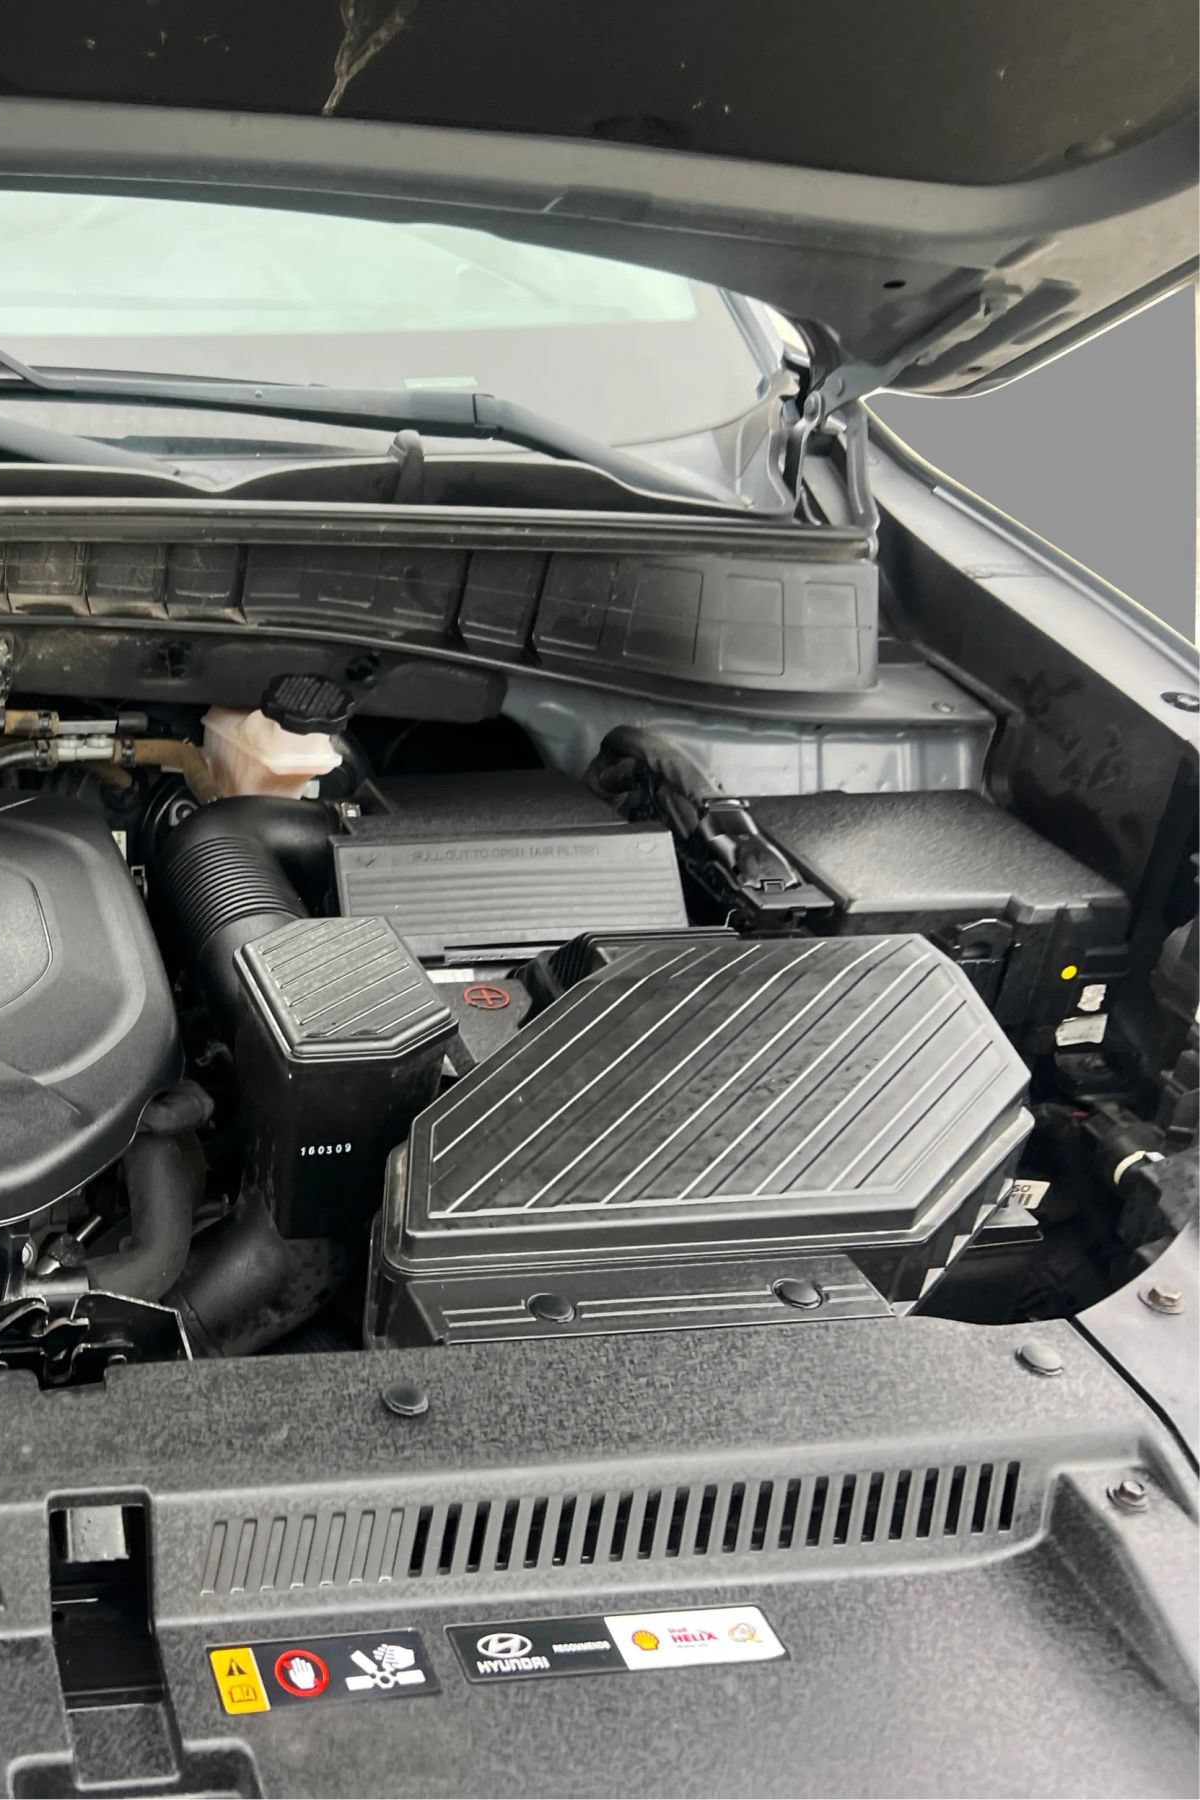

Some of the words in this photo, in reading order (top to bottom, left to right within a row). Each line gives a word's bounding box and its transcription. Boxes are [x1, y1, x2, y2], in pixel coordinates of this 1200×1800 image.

[300, 1142, 352, 1157] 160309
[670, 1630, 719, 1644] HELIX
[476, 1656, 550, 1674] HYUNDAI
